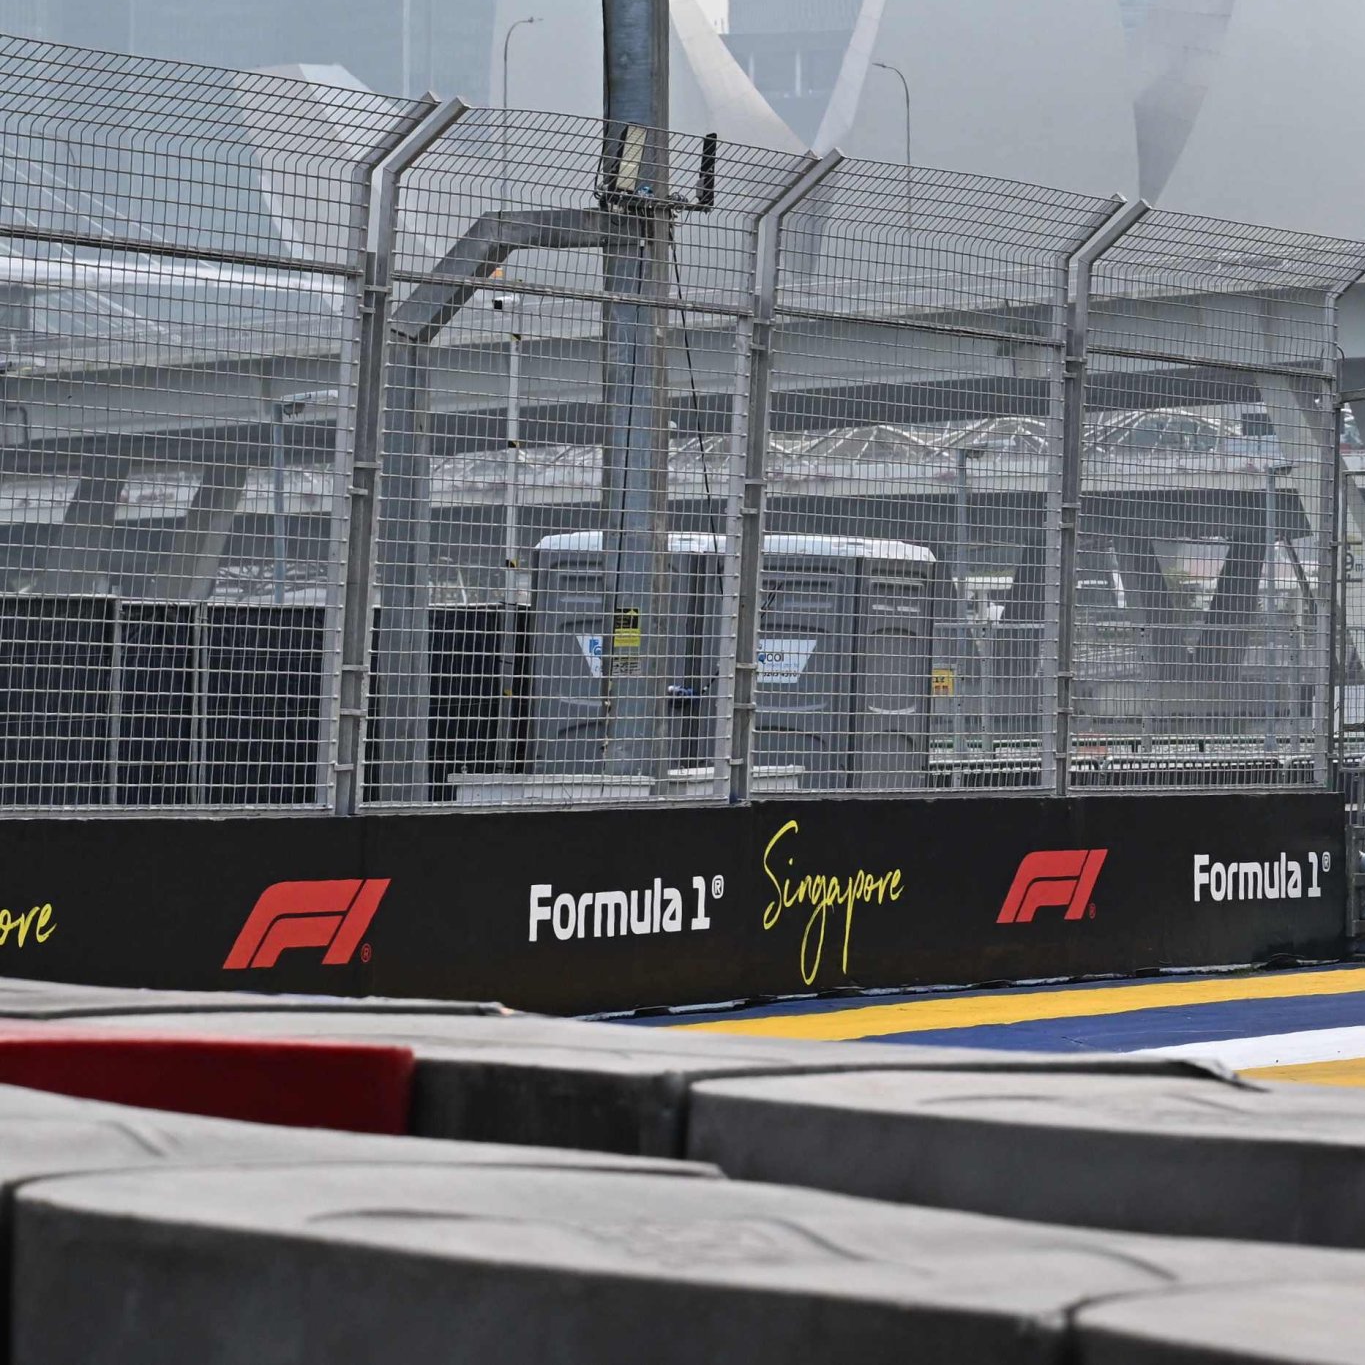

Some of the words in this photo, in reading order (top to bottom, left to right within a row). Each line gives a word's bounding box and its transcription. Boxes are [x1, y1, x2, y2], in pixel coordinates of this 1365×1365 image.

[528, 877, 683, 942] Formula
[763, 820, 903, 985] Singapore
[1193, 852, 1302, 902] Formula
